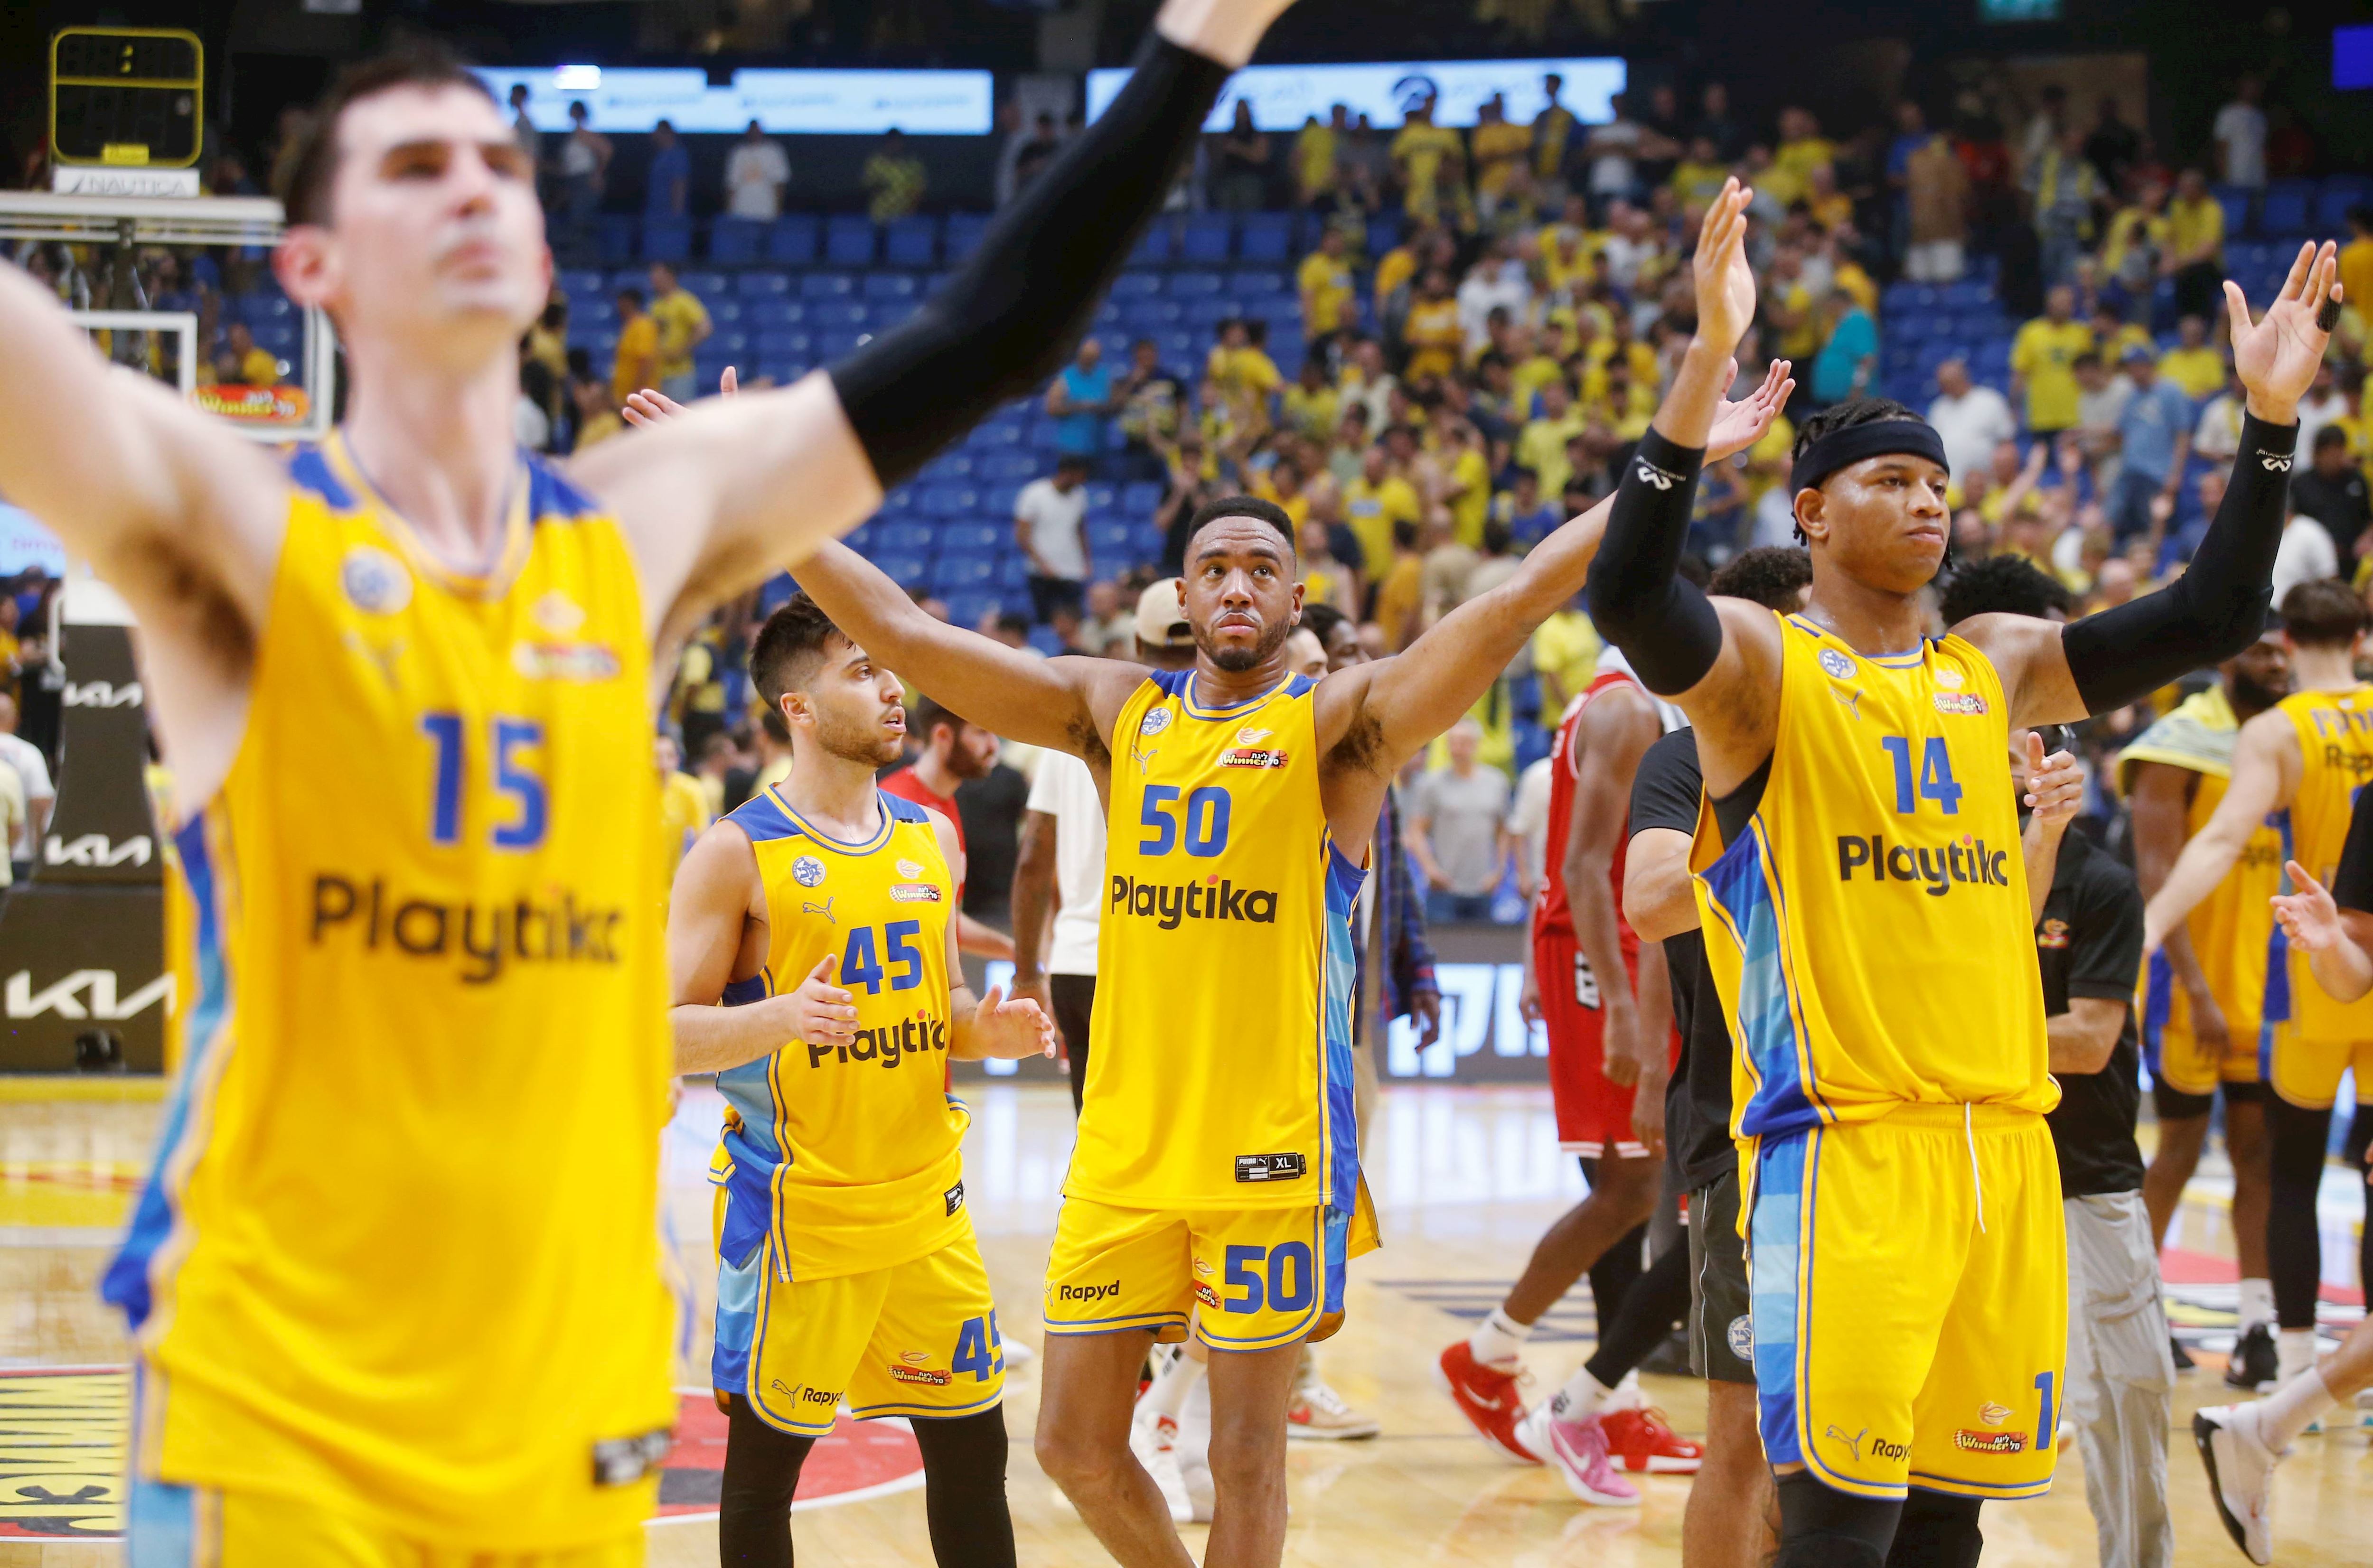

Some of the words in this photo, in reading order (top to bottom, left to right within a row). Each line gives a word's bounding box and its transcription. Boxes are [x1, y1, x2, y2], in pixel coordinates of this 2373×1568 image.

[422, 714, 547, 846] 15
[1223, 754, 1268, 766] Winner
[1881, 736, 1963, 815] 14
[1139, 784, 1231, 857] 50
[896, 889, 930, 899] Winner
[1111, 874, 1278, 930] Playtika
[840, 919, 922, 995] 45
[1276, 1157, 1292, 1169] XL
[1060, 1279, 1120, 1302] Rapyd
[1224, 1241, 1313, 1314] 50
[893, 1370, 933, 1383] Winner
[2035, 1371, 2066, 1450] 1
[1962, 1436, 2009, 1451] Winner
